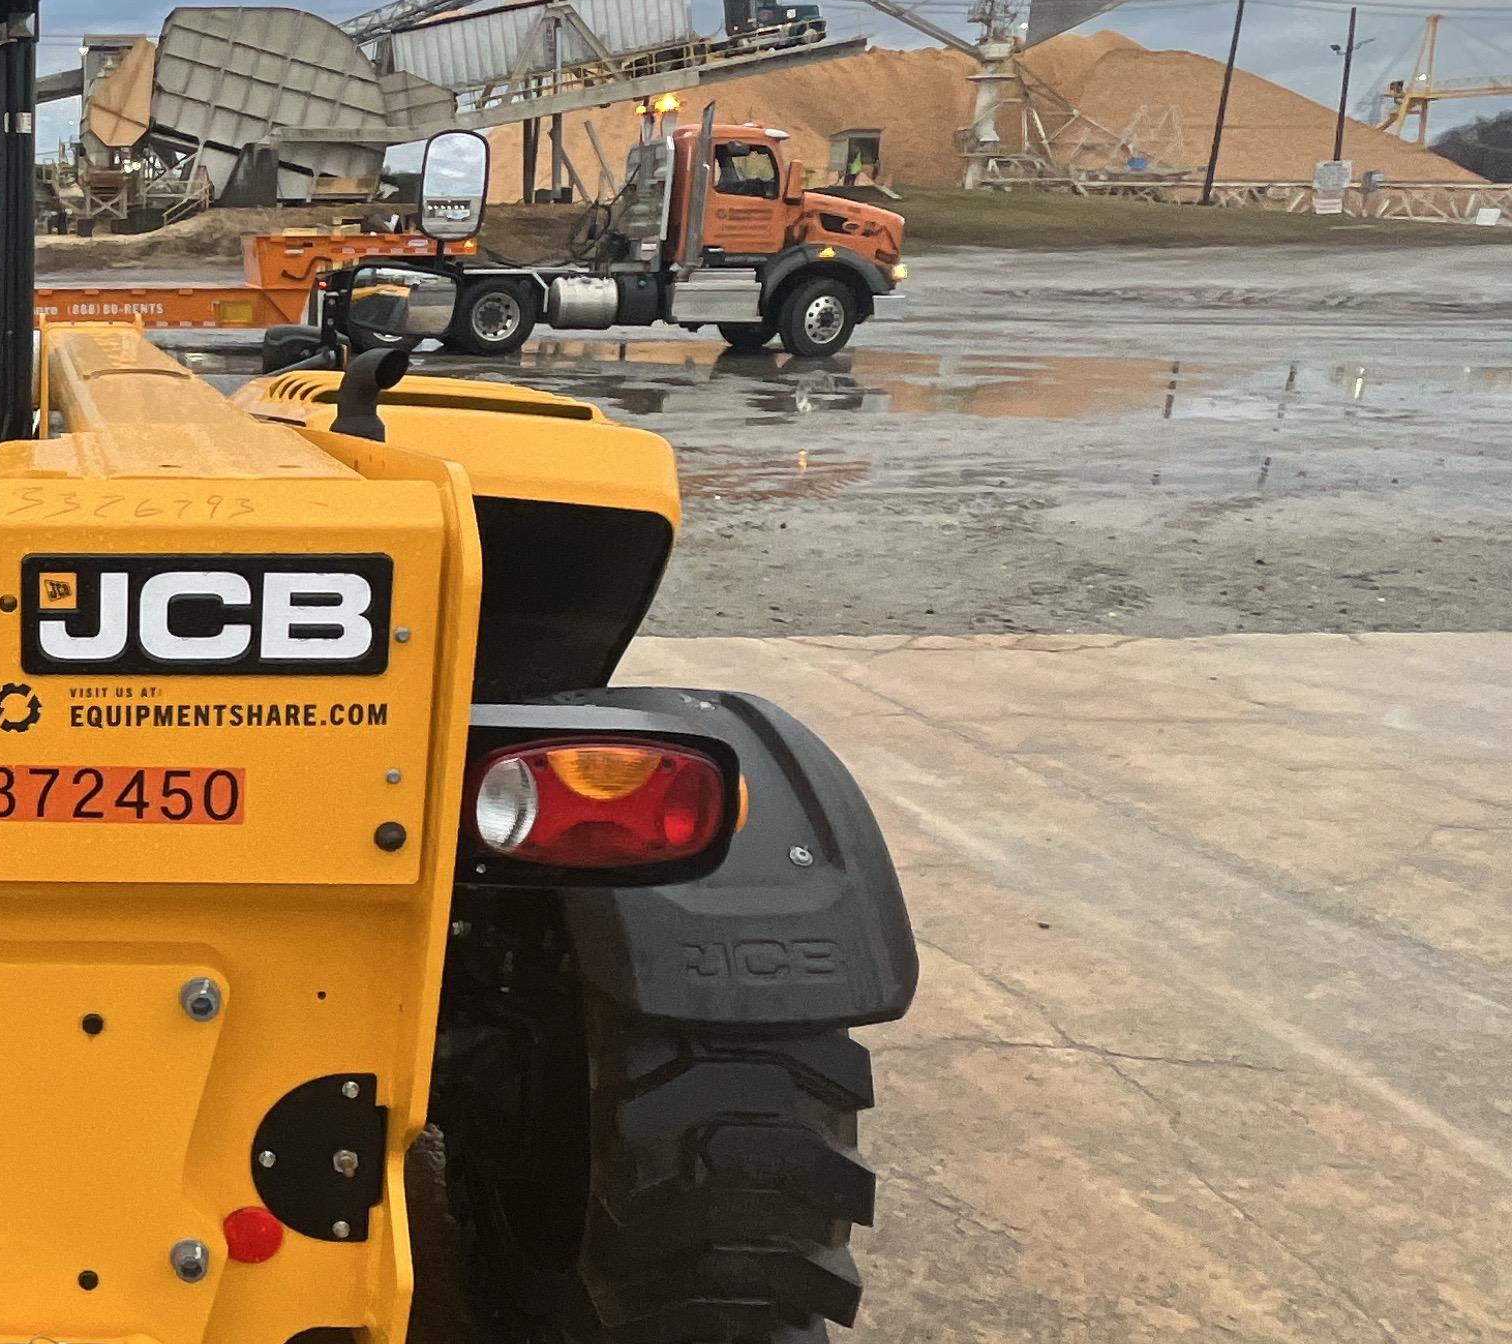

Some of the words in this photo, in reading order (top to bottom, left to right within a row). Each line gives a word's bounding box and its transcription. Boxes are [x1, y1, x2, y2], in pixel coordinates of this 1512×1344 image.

[39, 571, 373, 660] JCB
[69, 687, 109, 699] VISIT
[115, 687, 134, 699] US
[70, 703, 389, 729] EQUIPMENTSHARE.COM
[685, 938, 848, 986] JCB
